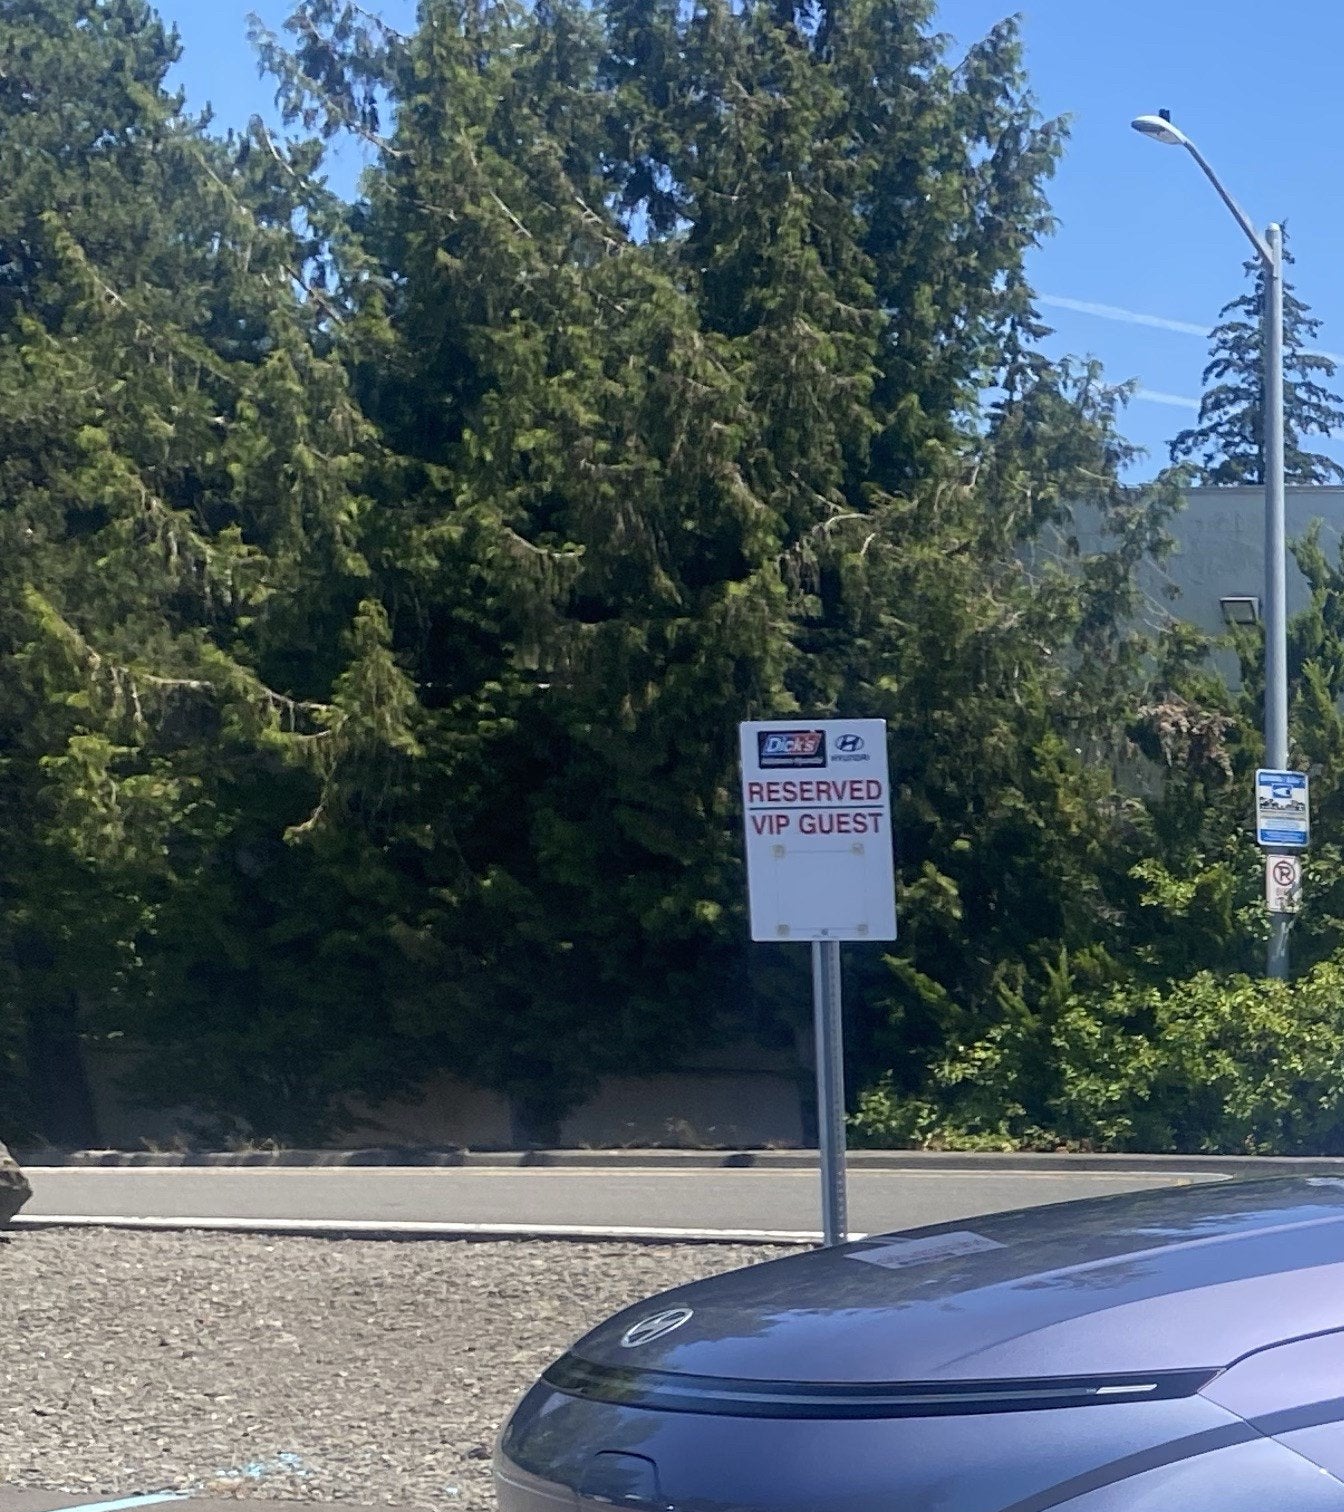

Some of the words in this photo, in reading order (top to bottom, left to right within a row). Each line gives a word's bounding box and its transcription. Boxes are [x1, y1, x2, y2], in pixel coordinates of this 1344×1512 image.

[748, 780, 882, 803] RESERVED
[752, 814, 790, 835] VIP
[799, 812, 884, 835] GUEST
